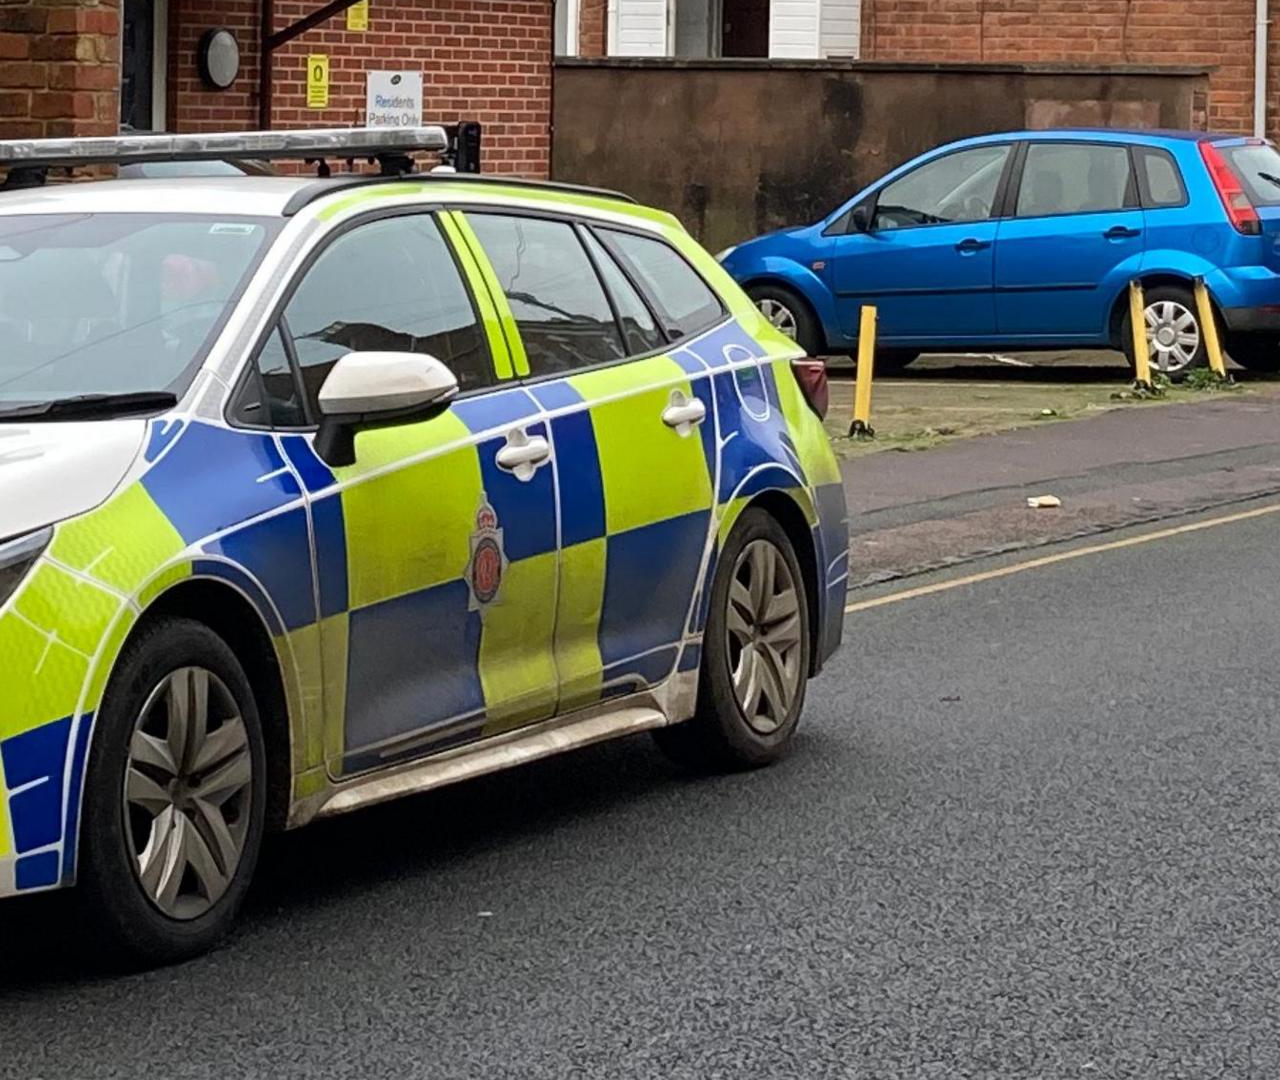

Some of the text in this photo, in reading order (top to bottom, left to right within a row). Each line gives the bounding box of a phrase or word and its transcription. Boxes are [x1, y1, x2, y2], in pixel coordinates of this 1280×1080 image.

[375, 94, 415, 109] Residents
[369, 112, 420, 126] Parking Only
